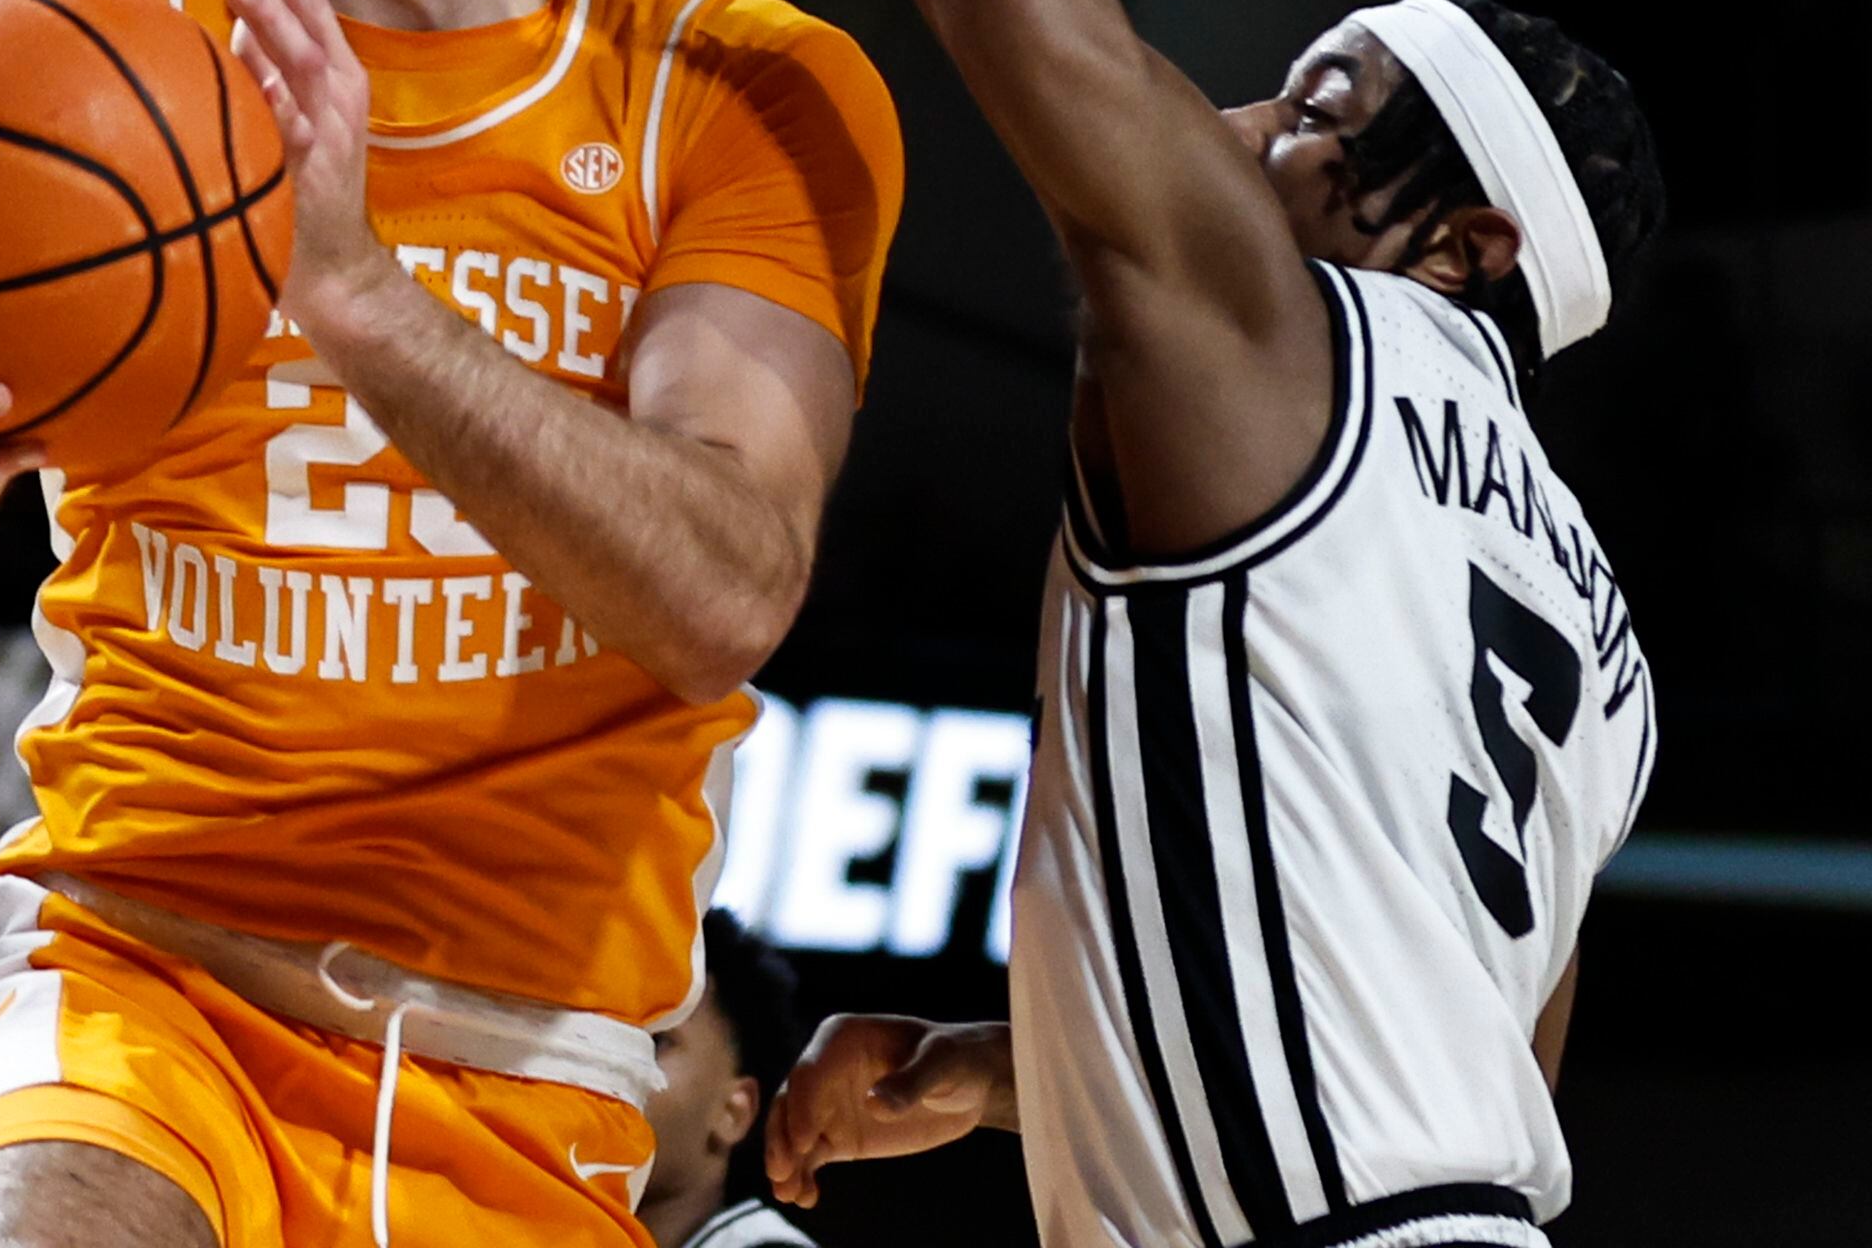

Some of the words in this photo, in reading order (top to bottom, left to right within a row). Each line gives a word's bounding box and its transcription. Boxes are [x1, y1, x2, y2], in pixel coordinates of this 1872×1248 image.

[566, 146, 618, 190] SEC
[264, 358, 500, 557] 2
[1447, 558, 1583, 942] 5
